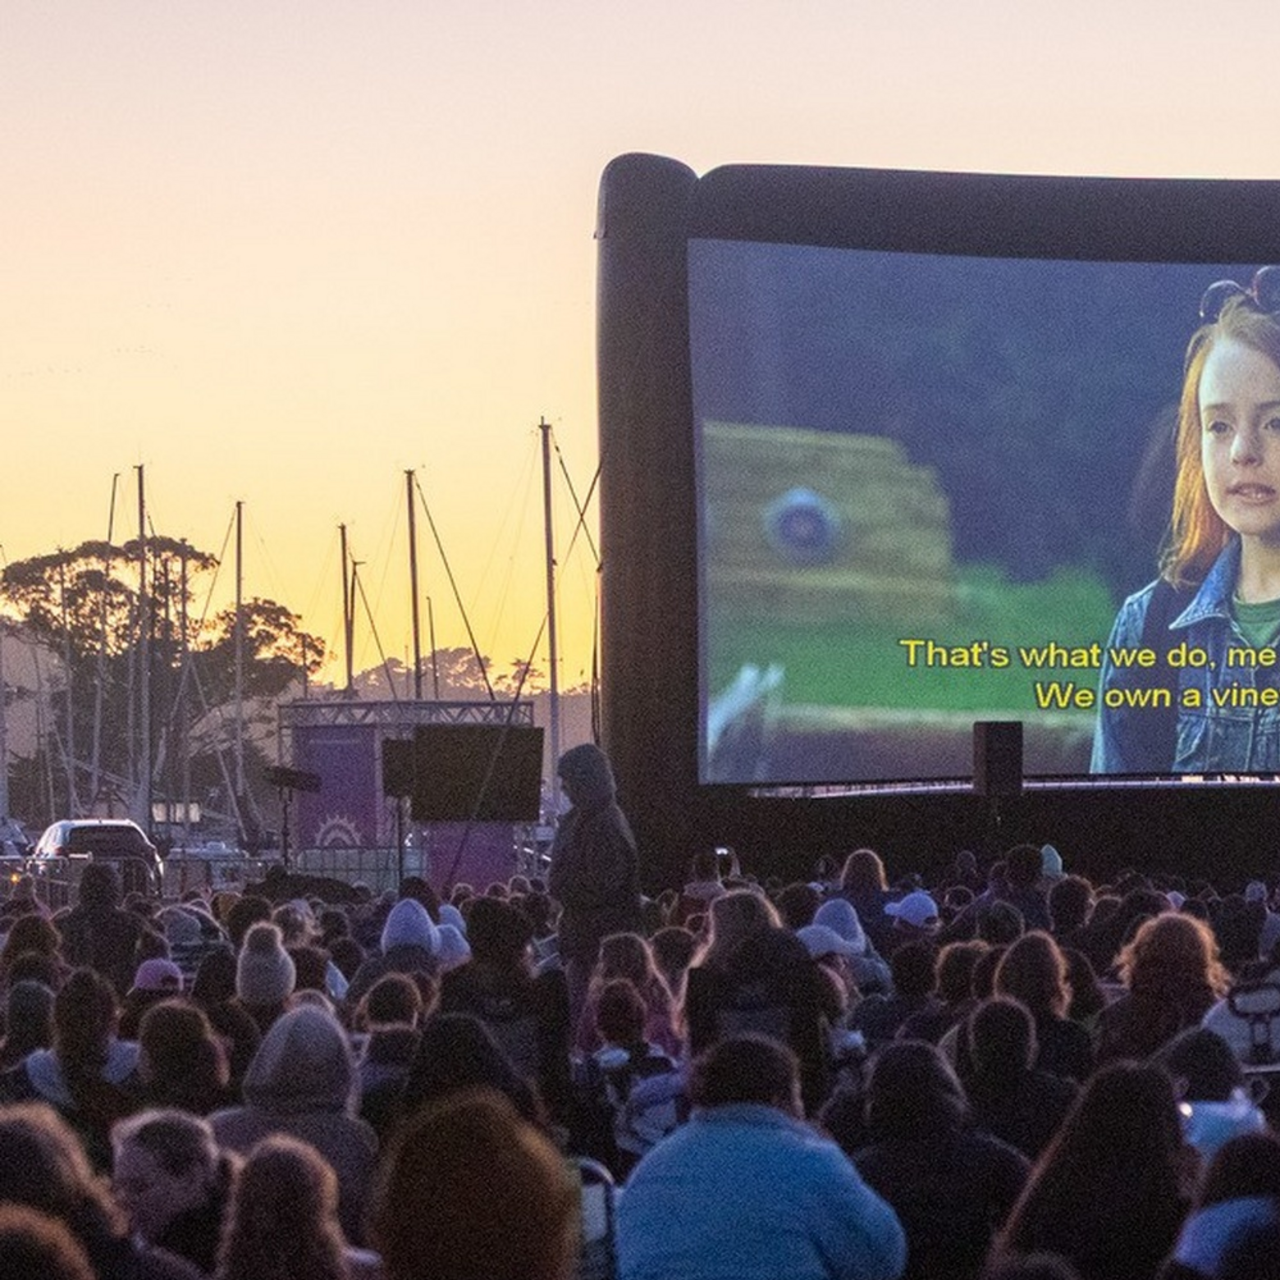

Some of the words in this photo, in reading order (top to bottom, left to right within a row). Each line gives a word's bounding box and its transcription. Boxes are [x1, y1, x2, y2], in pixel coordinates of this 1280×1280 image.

[899, 638, 1010, 668] That's
[1018, 642, 1102, 669] what
[1110, 647, 1157, 668] we
[1166, 642, 1216, 670] do,
[1227, 646, 1277, 667] me
[1035, 681, 1095, 709] We
[1104, 687, 1172, 708] own
[1182, 687, 1202, 707] a
